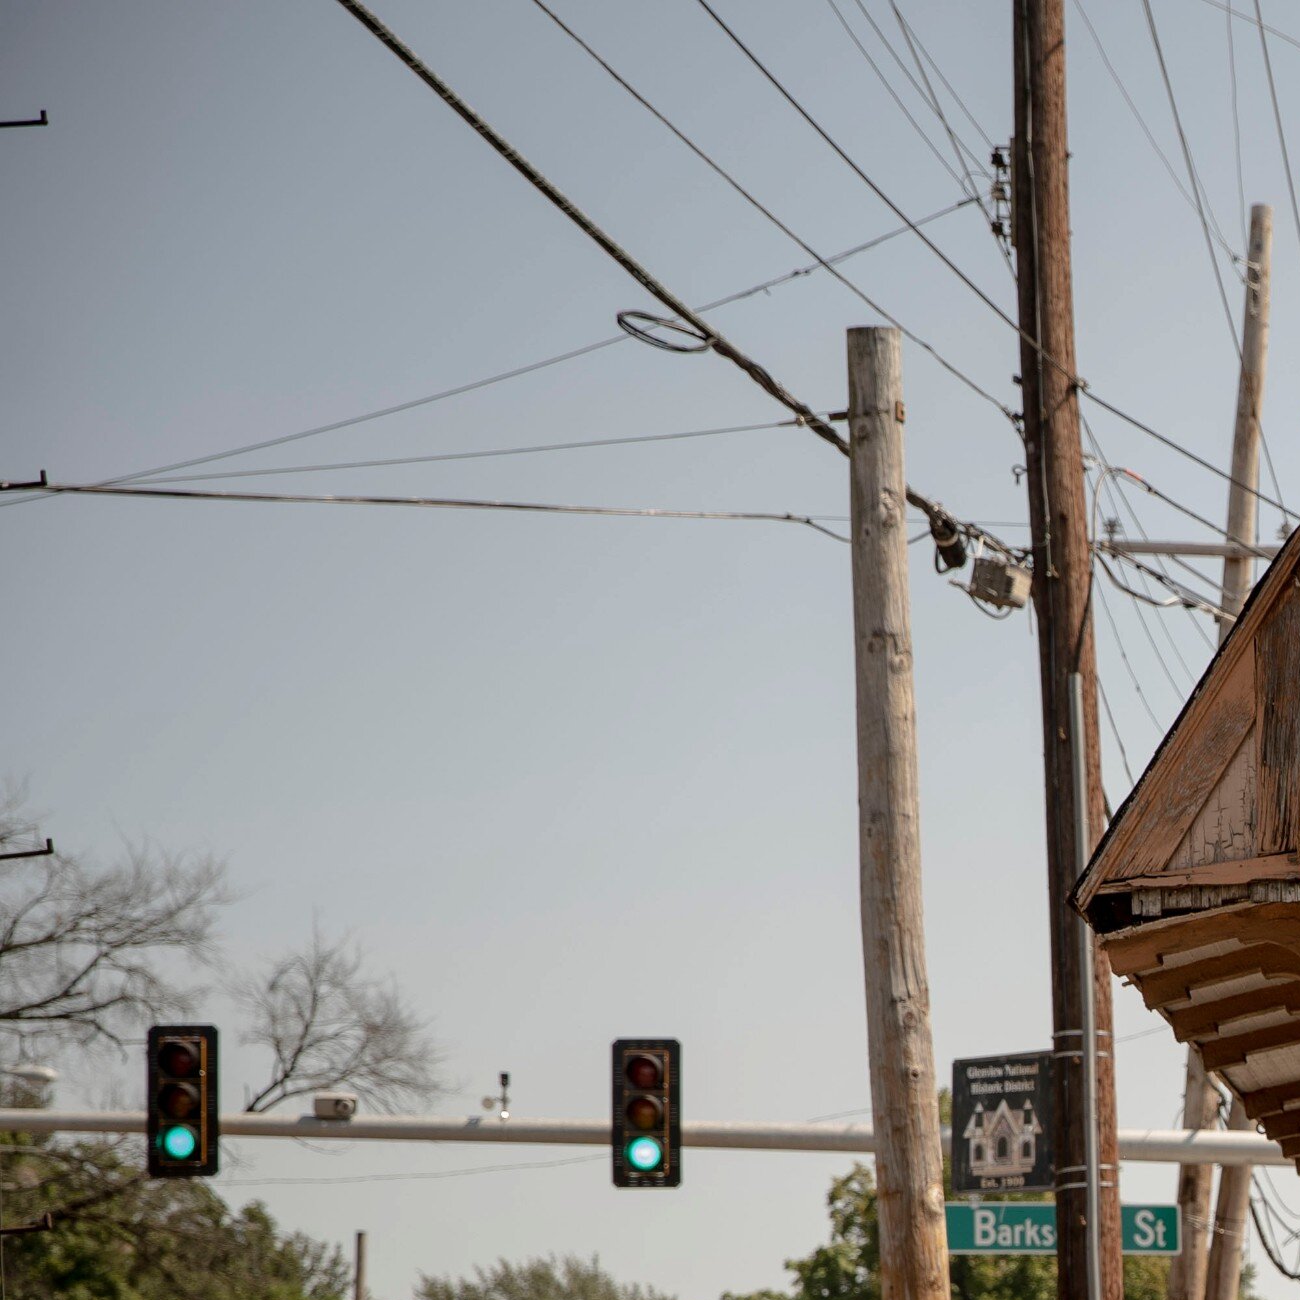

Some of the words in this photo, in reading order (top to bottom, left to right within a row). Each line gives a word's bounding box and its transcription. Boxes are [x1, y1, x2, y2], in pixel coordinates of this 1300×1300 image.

[1004, 1062, 1039, 1076] National
[970, 1081, 1003, 1095] Historic
[1004, 1079, 1035, 1092] District
[973, 1209, 1057, 1247] Barks
[1133, 1209, 1167, 1248] St
